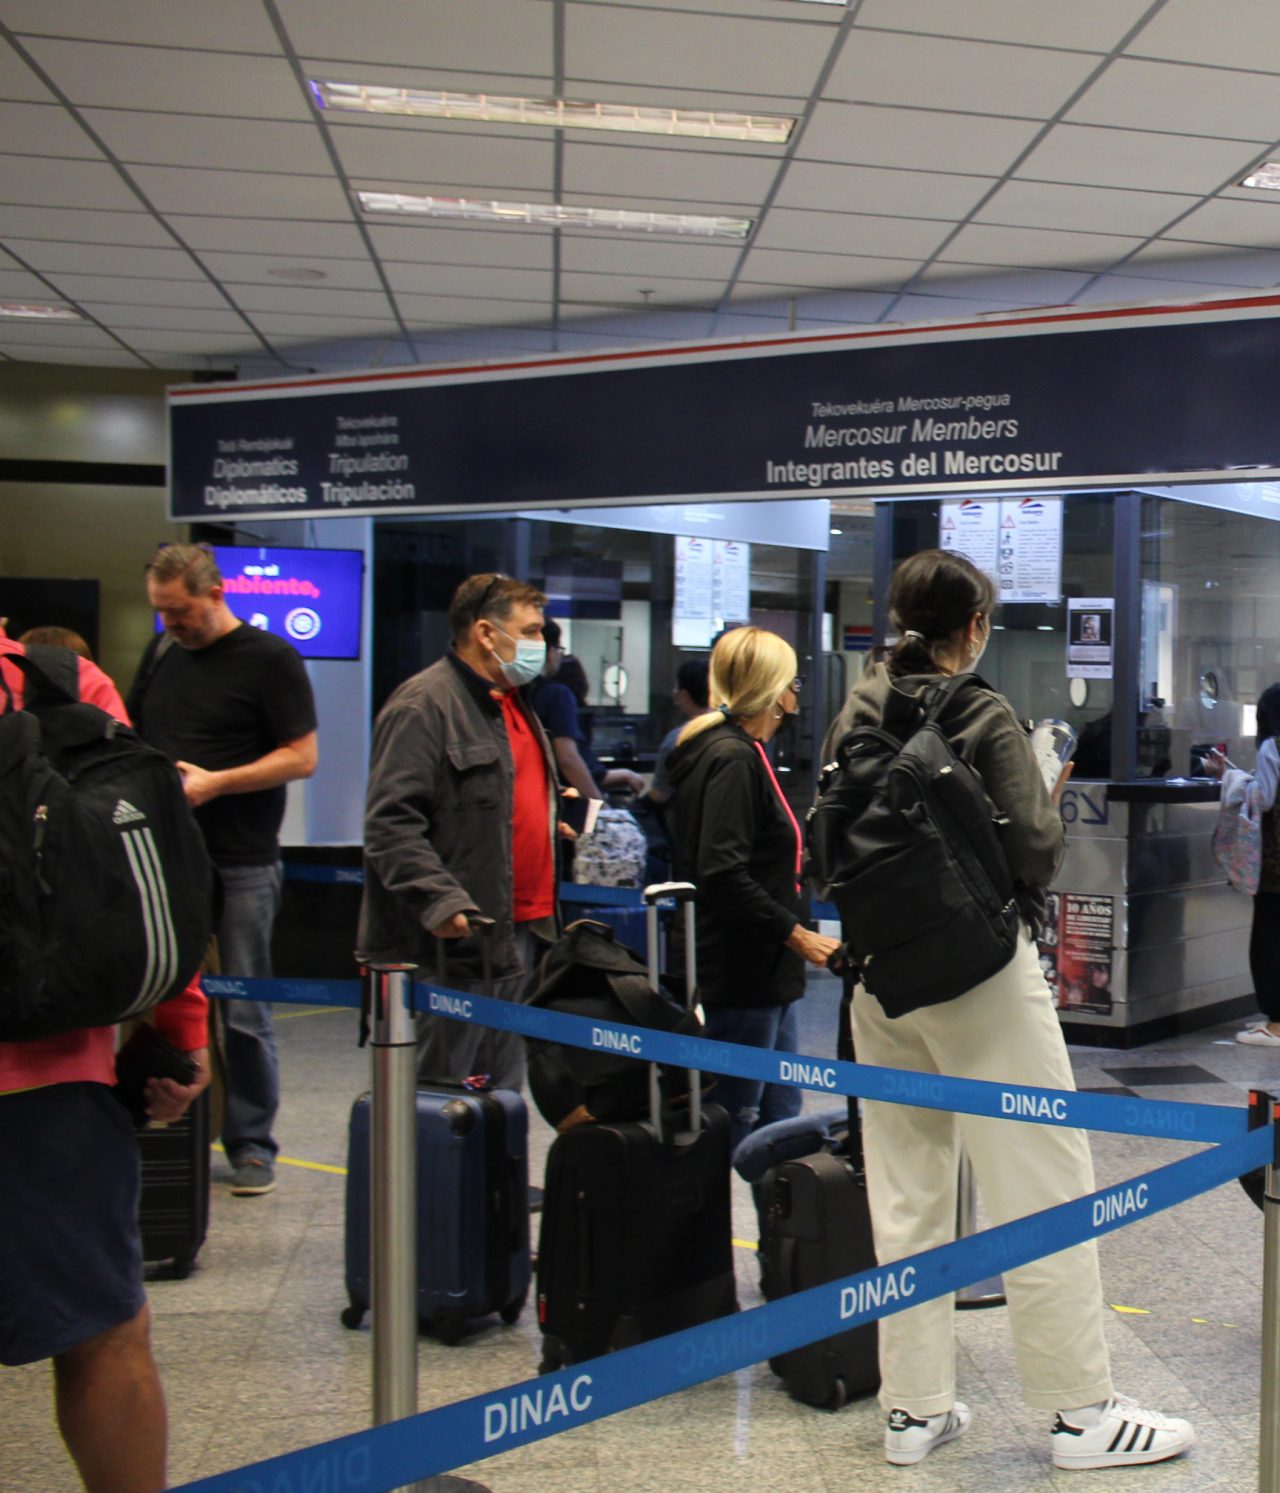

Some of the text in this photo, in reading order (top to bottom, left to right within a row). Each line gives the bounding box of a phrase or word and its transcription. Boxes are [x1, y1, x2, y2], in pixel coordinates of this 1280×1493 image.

[811, 393, 1011, 418] Tekovekuéra Mercosur-pegua
[804, 416, 1019, 448] Mercosur Members
[213, 457, 298, 481] Diplomatics
[328, 452, 408, 477] Tripulation
[766, 450, 1063, 487] Integrantes del Mercosur
[204, 484, 308, 509] Diplomáticos
[320, 479, 415, 506] Tripulación
[1060, 790, 1079, 823] 6
[1066, 902, 1113, 916] 10 AÑOS
[203, 978, 247, 996] DINAC
[429, 992, 473, 1018] DINAC
[592, 1027, 642, 1054] DINAC
[779, 1060, 837, 1089] DINAC
[1001, 1092, 1067, 1120] DINAC
[1092, 1183, 1149, 1227] DINAC
[840, 1266, 917, 1319] DINAC
[484, 1374, 593, 1443] DINAC
